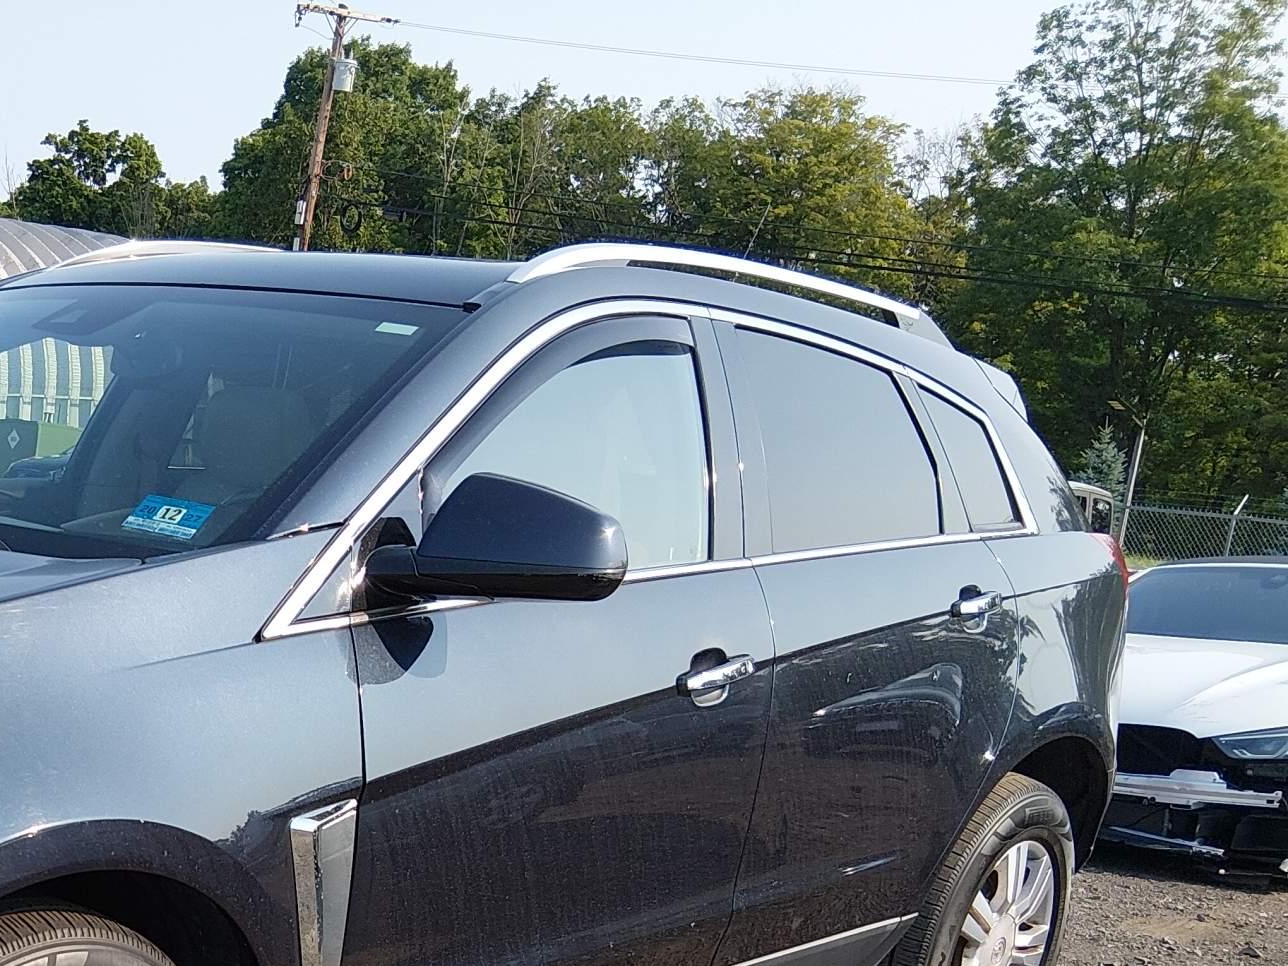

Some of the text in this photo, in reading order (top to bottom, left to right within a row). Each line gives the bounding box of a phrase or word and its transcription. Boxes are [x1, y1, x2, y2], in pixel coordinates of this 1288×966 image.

[140, 504, 204, 522] 20 12 27
